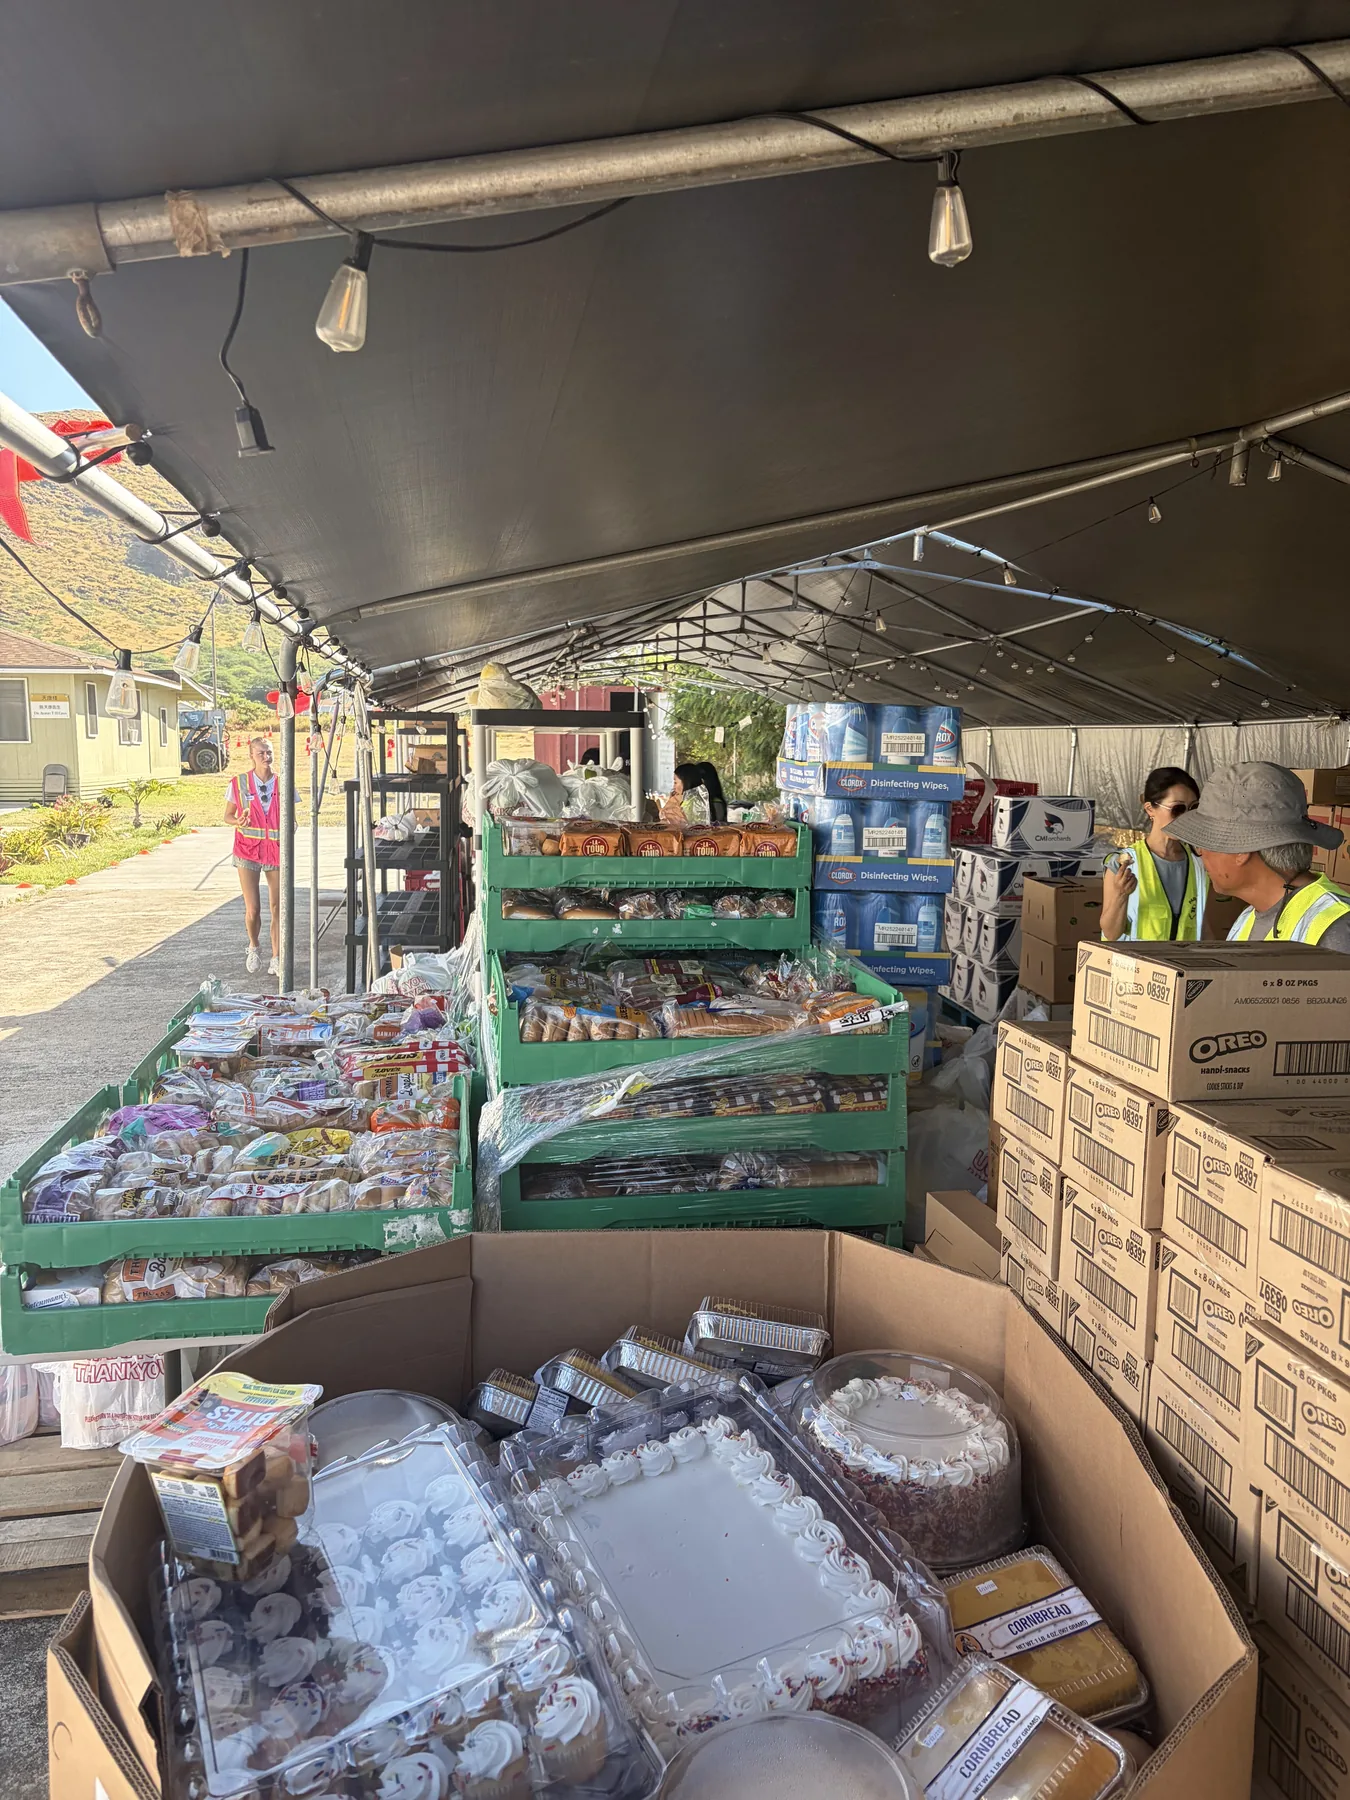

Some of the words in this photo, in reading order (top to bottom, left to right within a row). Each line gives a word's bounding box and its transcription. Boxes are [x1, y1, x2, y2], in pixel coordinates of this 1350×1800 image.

[840, 778, 864, 788] CLOROX
[870, 779, 919, 790] Disinfecting
[586, 845, 605, 854] TOUR
[697, 847, 715, 856] TOUR
[831, 870, 854, 879] CLOROX
[860, 871, 909, 881] Disinfecting
[1115, 982, 1144, 997] OREO
[1147, 982, 1170, 1002] 08397
[1277, 978, 1283, 987] 8
[1285, 979, 1296, 987] OZ
[1297, 979, 1319, 987] PKGS
[1189, 1030, 1267, 1064] OREO
[1024, 1058, 1043, 1072] OREO
[1046, 1060, 1061, 1079] 08397
[1105, 1087, 1117, 1098] PKGS
[1095, 1102, 1120, 1120] OREO
[1122, 1106, 1143, 1130] 08397
[1214, 1138, 1227, 1151] PKGS
[1202, 1156, 1231, 1177] OREO
[1234, 1162, 1258, 1190] 08397
[1107, 1214, 1119, 1227] PKGS
[1098, 1228, 1123, 1250] OREO
[1125, 1238, 1146, 1265] 08397
[1202, 1271, 1207, 1282] 8
[1208, 1278, 1216, 1289] OZ
[1216, 1283, 1231, 1299] PKGS
[1259, 1281, 1288, 1313] 08397
[1202, 1298, 1236, 1325] OREO
[1292, 1299, 1335, 1329] OREO
[1300, 1329, 1319, 1347] PKGS
[1096, 1345, 1120, 1370] OREO
[1121, 1360, 1140, 1387] 08397
[1306, 1377, 1316, 1388] OZ
[1317, 1383, 1337, 1403] PKGS
[206, 1405, 278, 1427] BITES
[1301, 1401, 1346, 1436] OREO
[1007, 1603, 1072, 1636] CORNBREAD
[1069, 1619, 1089, 1631] GRAMS)
[959, 1708, 1021, 1779] CORNBREAD
[972, 1784, 982, 1795] NET
[981, 1773, 993, 1784] WT.
[1012, 1736, 1023, 1750] (567
[1021, 1715, 1041, 1737] GRAMS)
